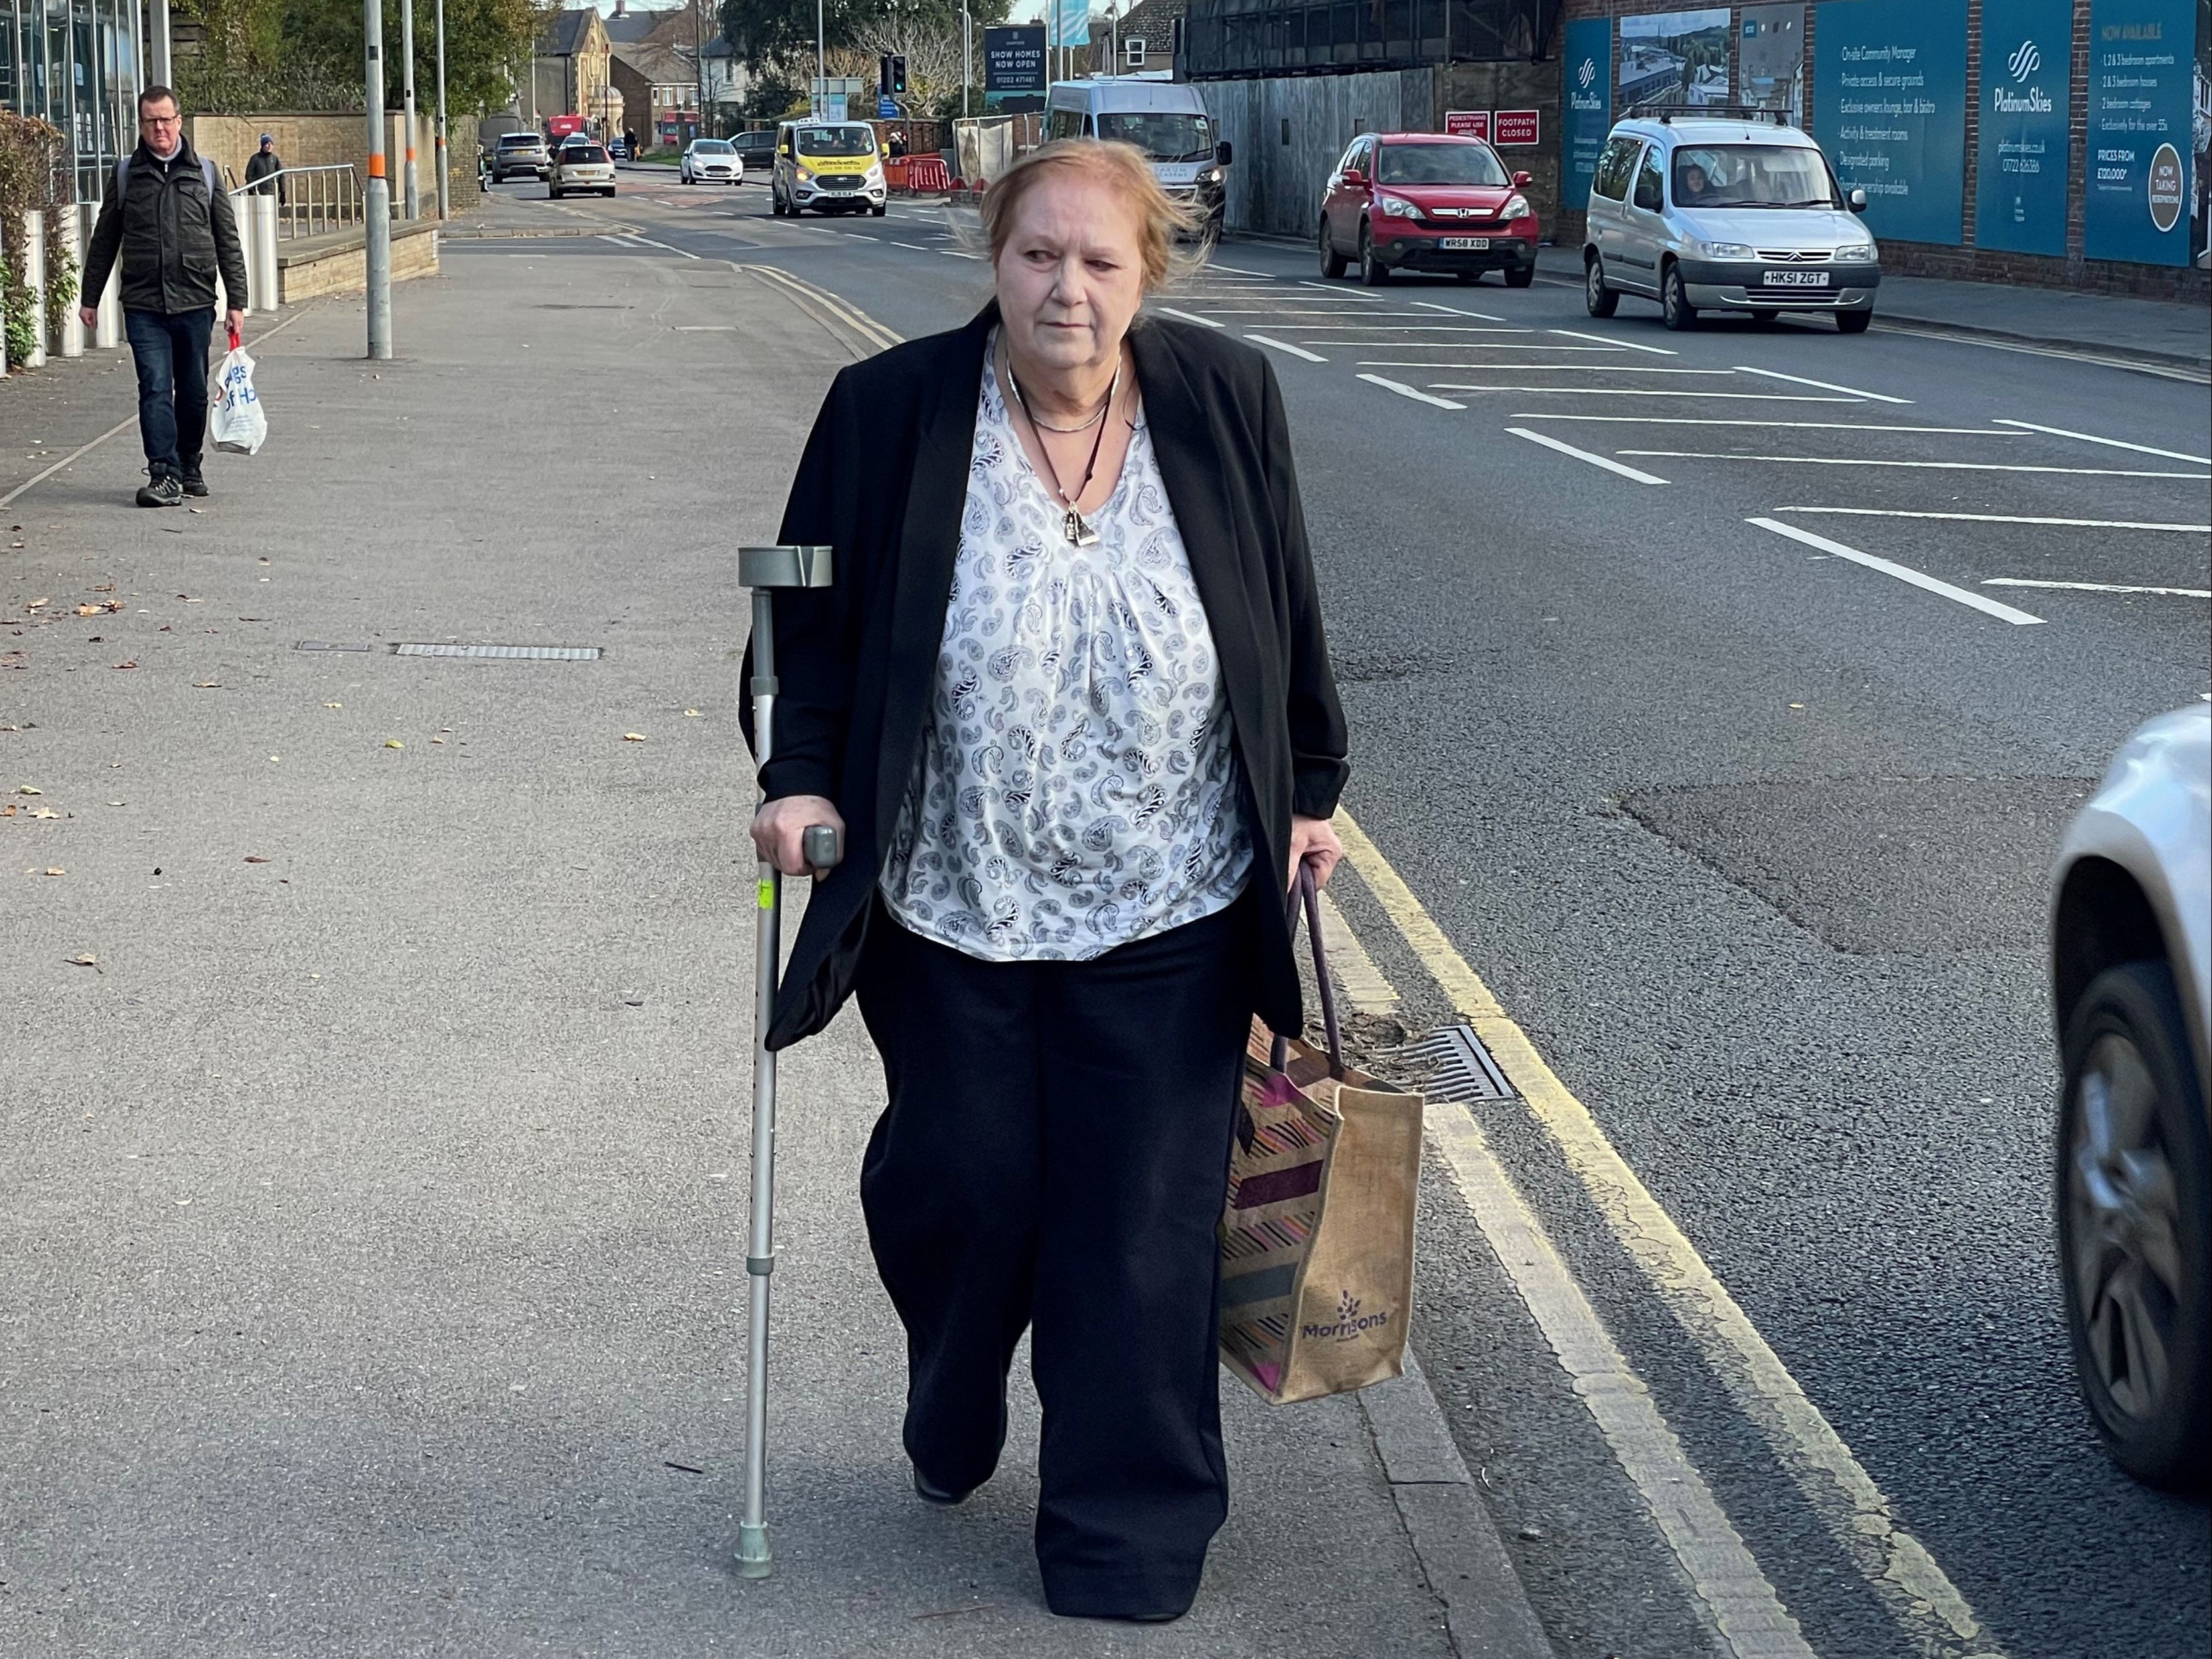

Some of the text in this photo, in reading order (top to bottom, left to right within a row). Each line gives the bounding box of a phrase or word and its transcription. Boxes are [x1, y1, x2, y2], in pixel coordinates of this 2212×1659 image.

[1861, 46, 1891, 63] Community
[1892, 45, 1917, 63] Manager
[2121, 53, 2144, 65] bedroom
[2145, 54, 2174, 66] apartments
[1842, 70, 1924, 90] Private access & secure grounds
[1904, 98, 1913, 114] bar
[1914, 98, 1918, 114] &
[2098, 149, 2134, 162] PRICES FROM
[2159, 166, 2173, 177] NOW
[2156, 179, 2176, 191] TAKING
[1771, 273, 1822, 284] HK51 ZGT
